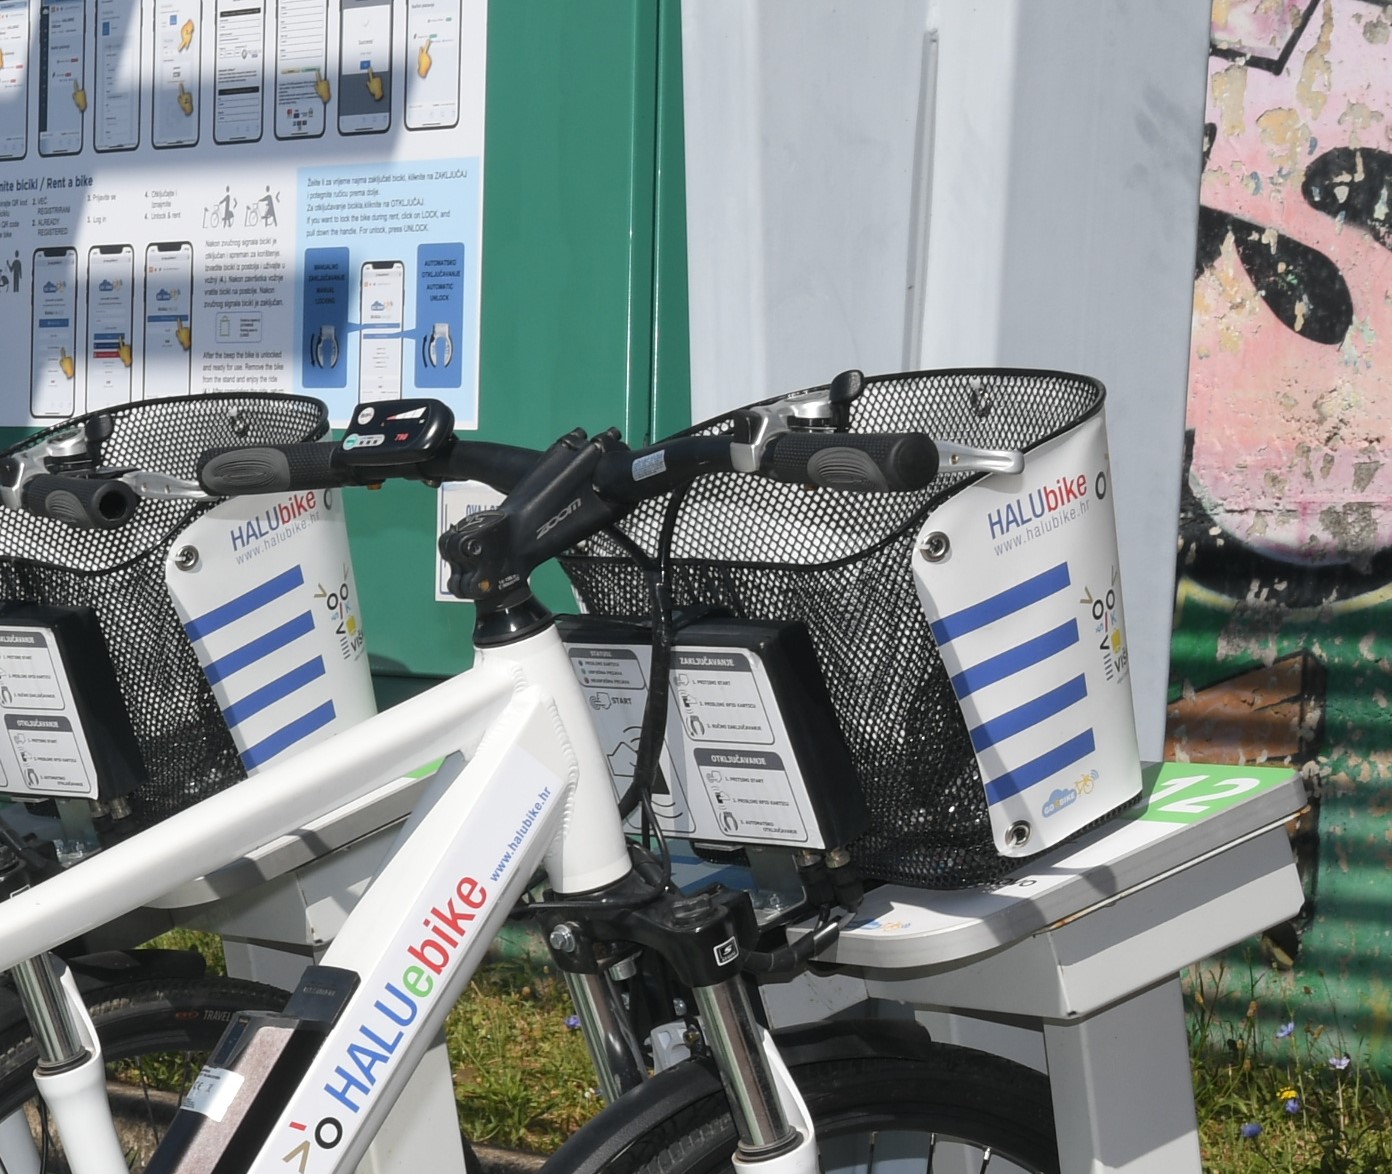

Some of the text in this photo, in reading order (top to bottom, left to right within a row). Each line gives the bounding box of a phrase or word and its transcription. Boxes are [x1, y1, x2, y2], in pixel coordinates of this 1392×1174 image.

[230, 490, 317, 552] HALUbike
[987, 474, 1088, 539] HALUbike
[993, 499, 1091, 557] www.halubike.hr
[611, 696, 632, 706] START
[489, 786, 552, 883] www.halubike.hr
[323, 876, 488, 1114] HALUebike
